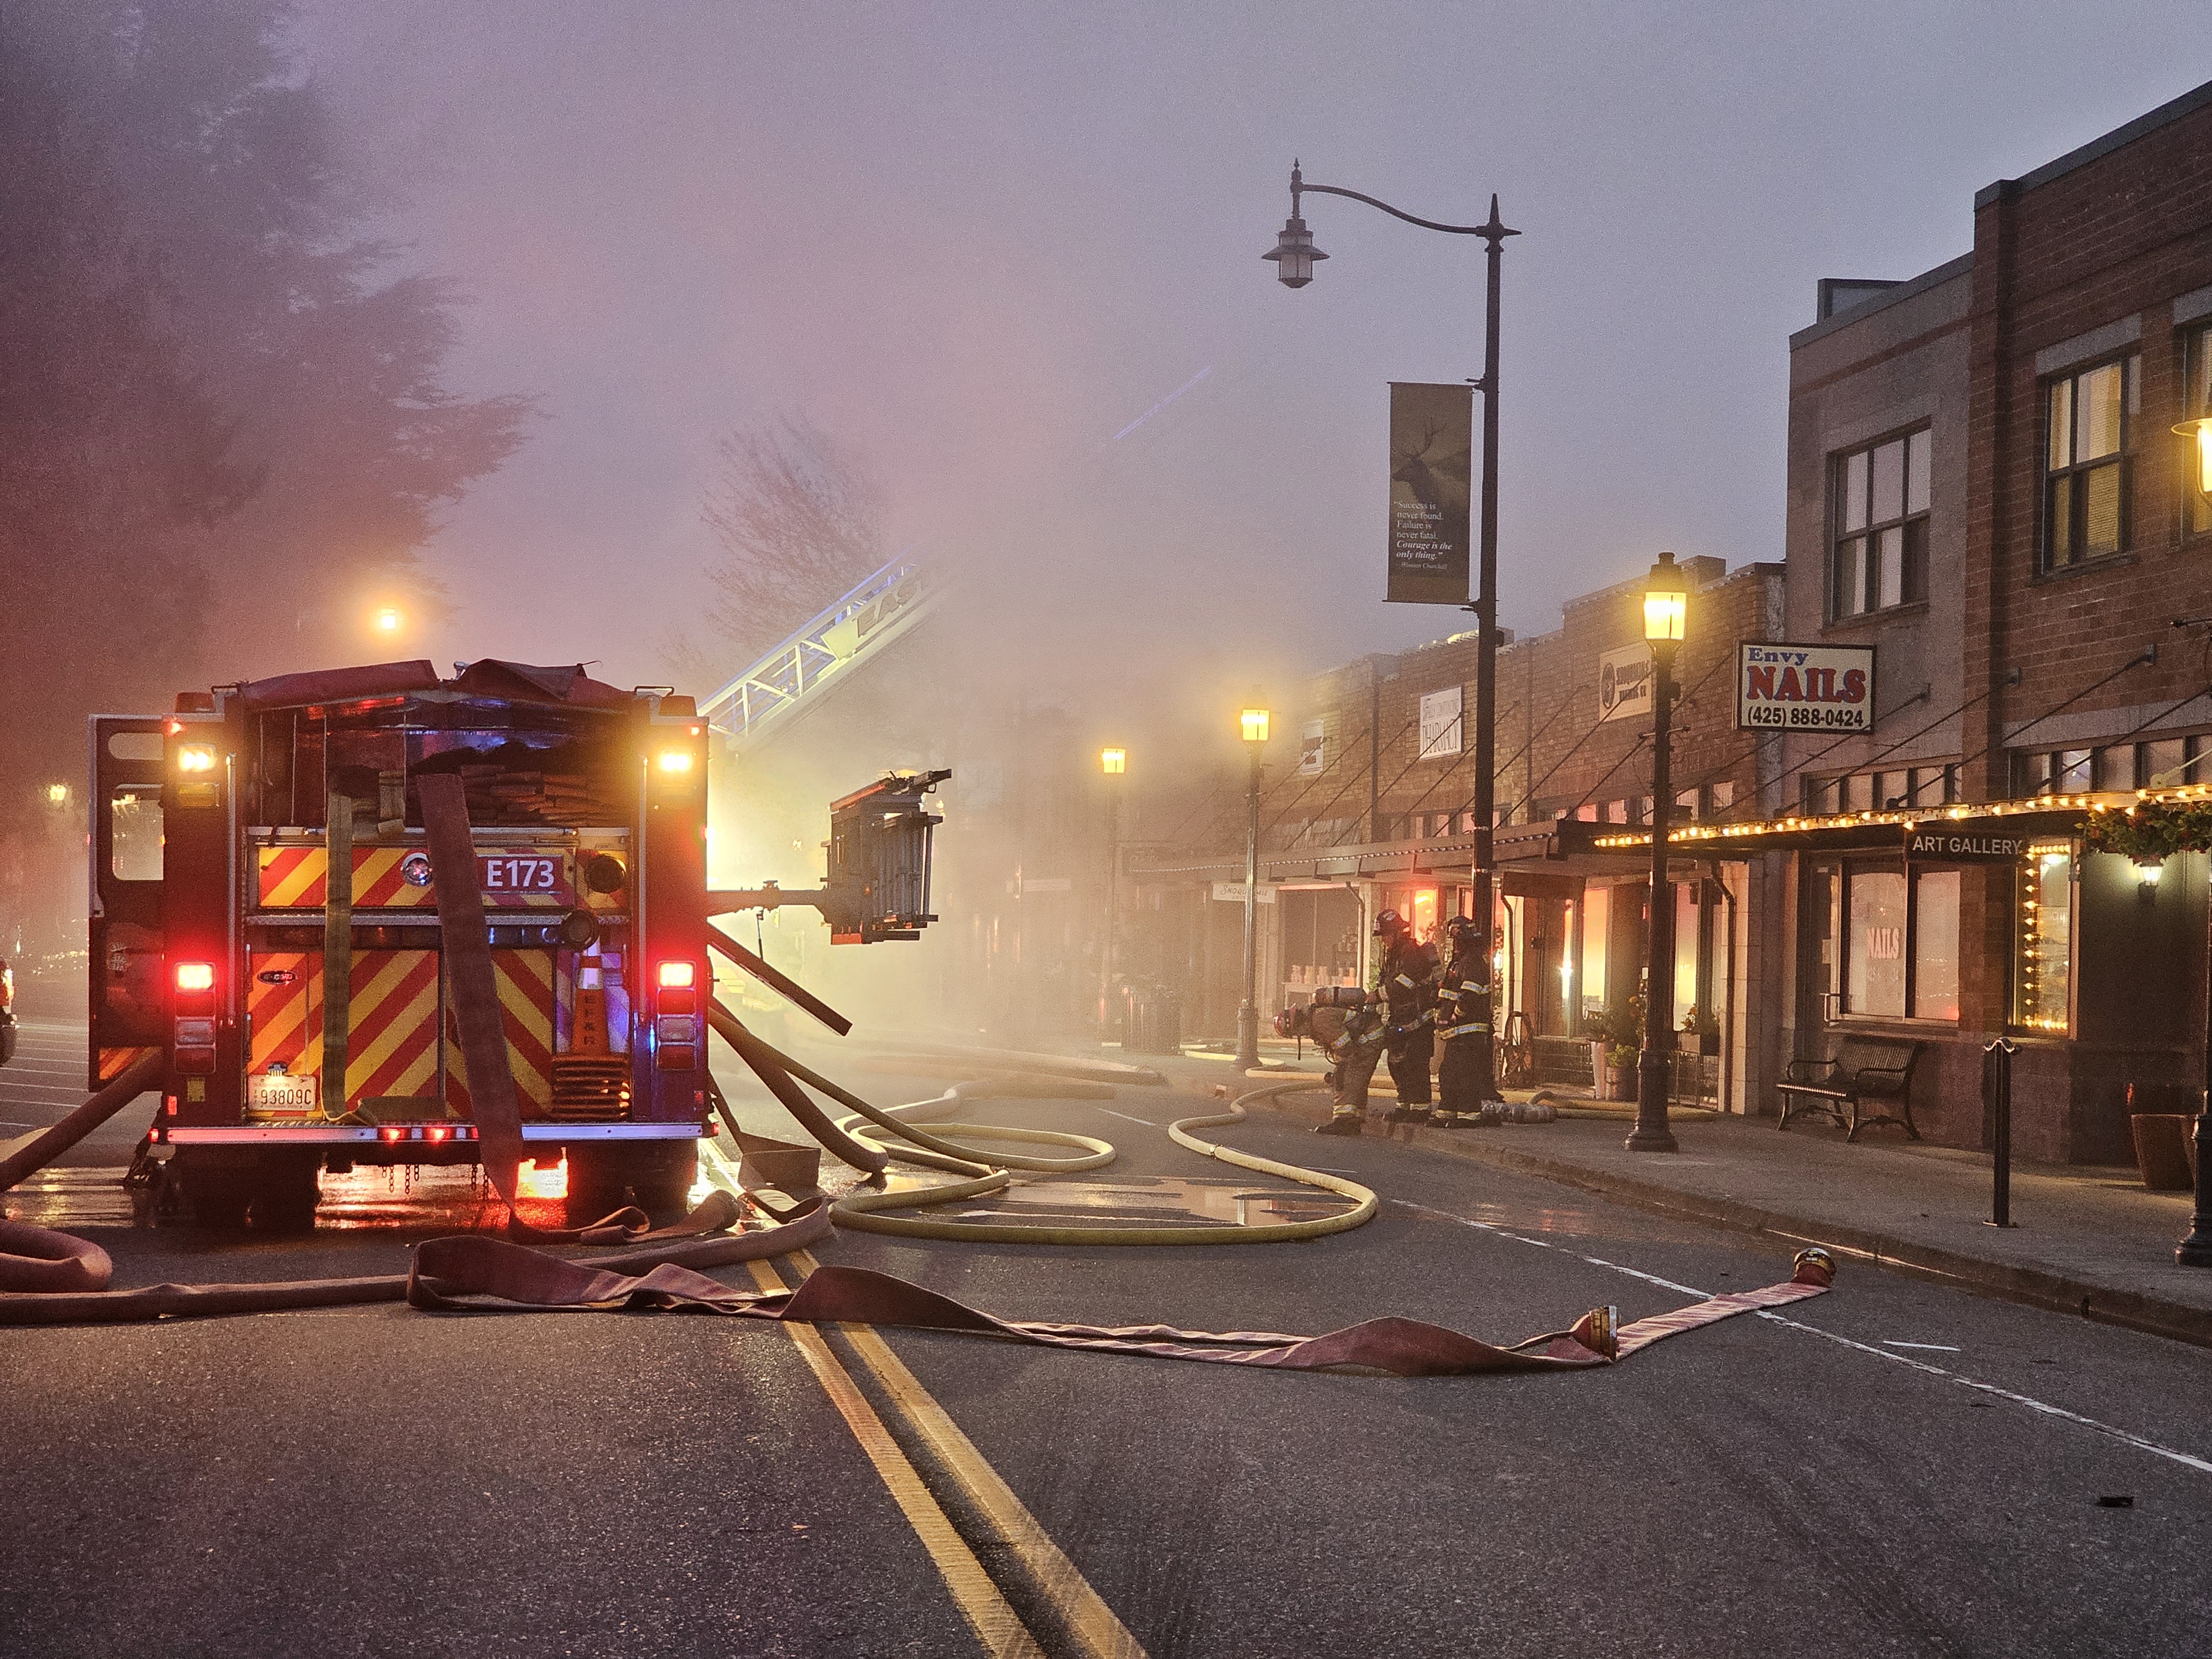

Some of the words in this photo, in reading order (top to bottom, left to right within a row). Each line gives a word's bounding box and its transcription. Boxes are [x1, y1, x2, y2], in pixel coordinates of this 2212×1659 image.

[1420, 512, 1444, 520] found.
[1397, 520, 1424, 529] Failure
[1420, 530, 1438, 540] fatal.
[1396, 540, 1431, 550] Courage
[1431, 541, 1438, 549] is
[1439, 542, 1453, 550] the
[1396, 550, 1414, 560] only
[1748, 647, 1808, 666] Envy
[1746, 665, 1866, 703] NAILS
[1747, 706, 1786, 726] (425)
[1791, 708, 1864, 727] 888-0424
[1912, 836, 1945, 852] ART
[1949, 837, 2022, 854] GALLERY
[486, 859, 555, 888] E173
[1867, 927, 1900, 960] NAILS
[260, 1089, 311, 1104] 93809C
